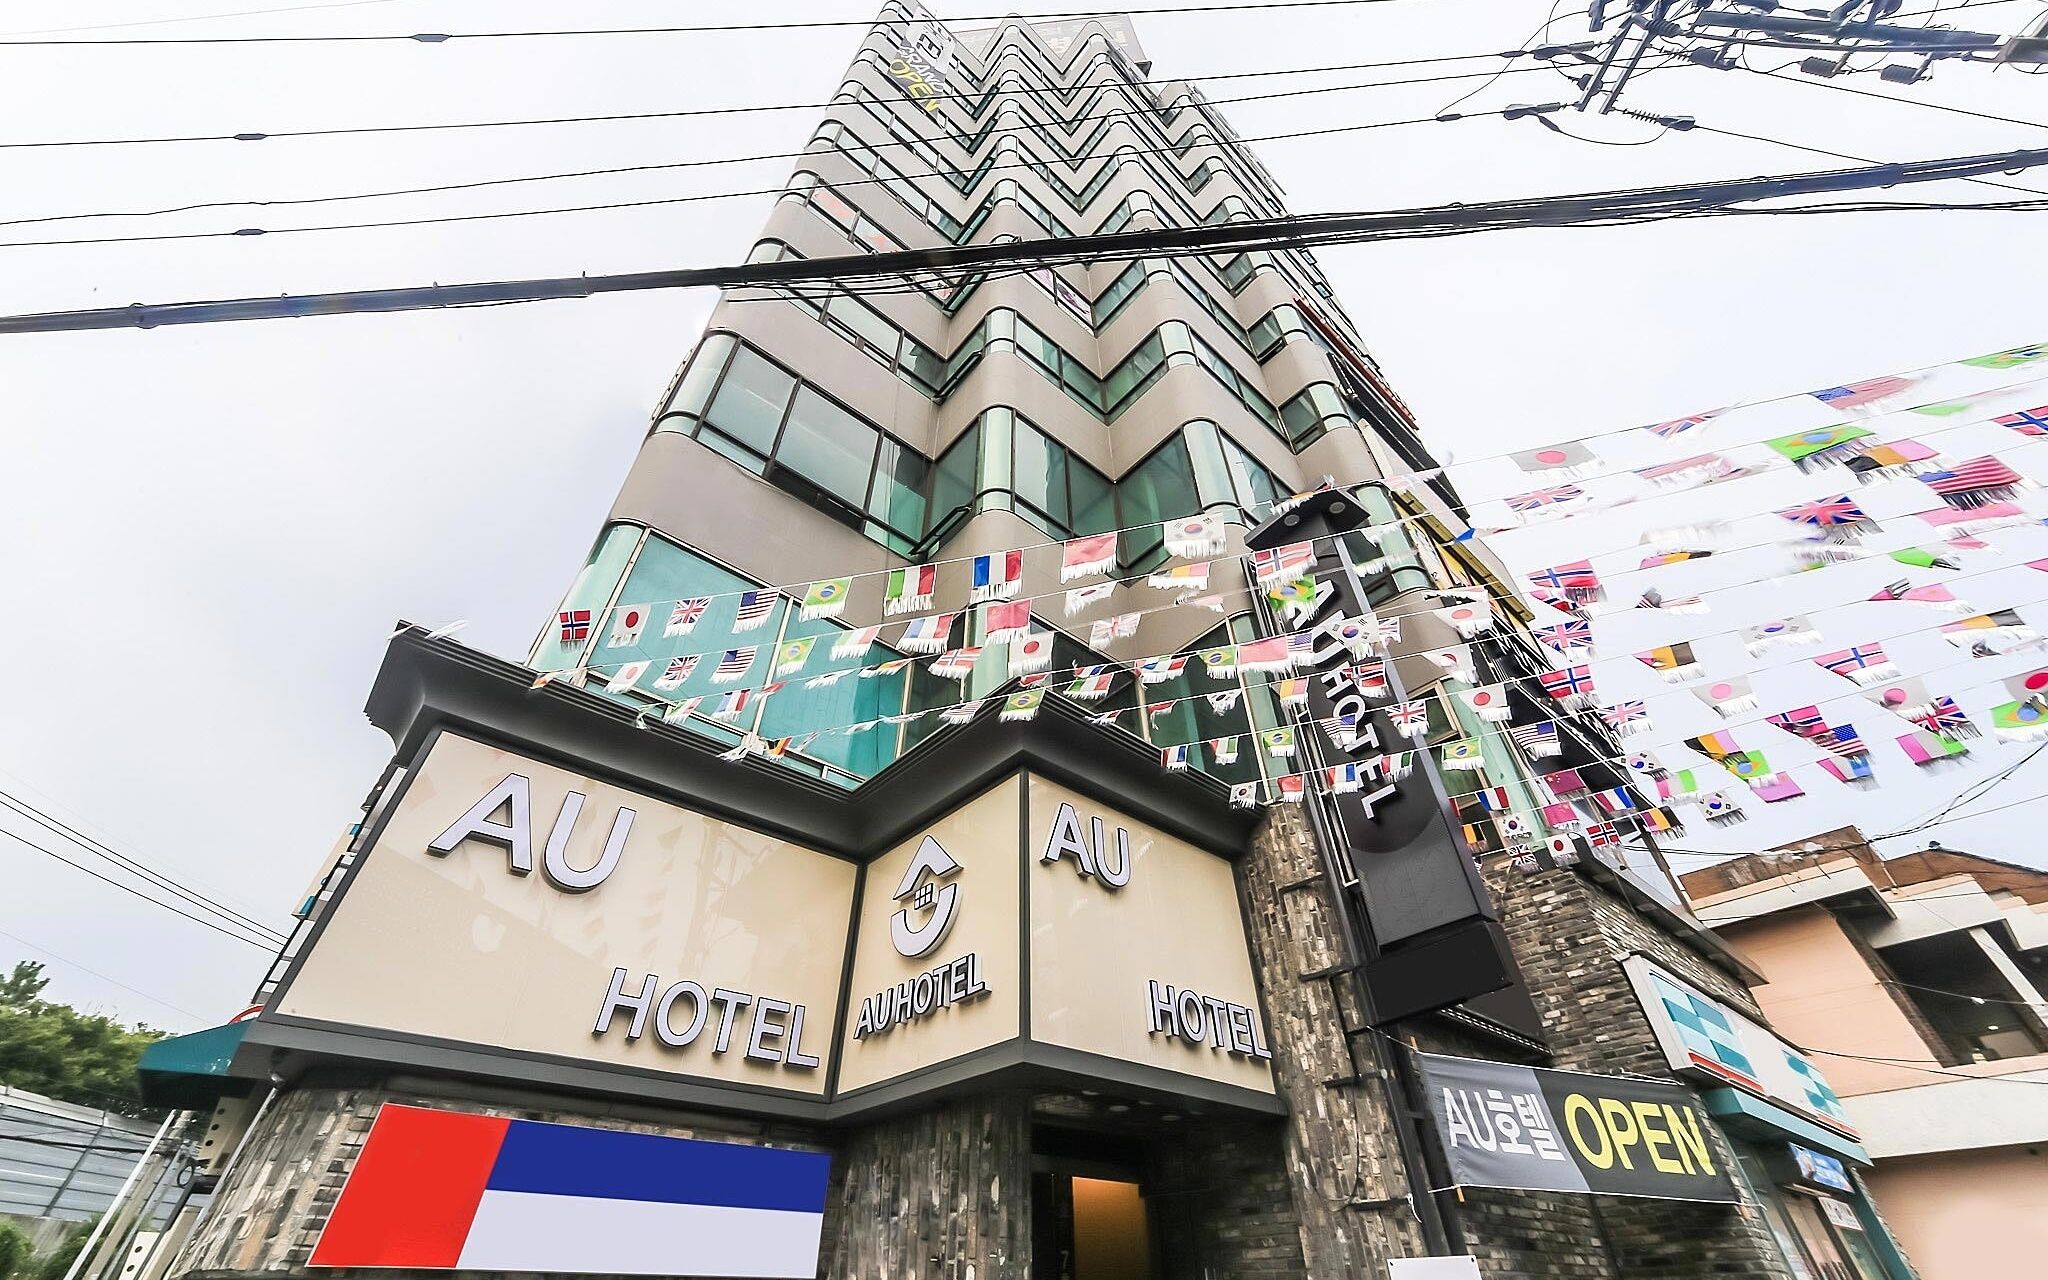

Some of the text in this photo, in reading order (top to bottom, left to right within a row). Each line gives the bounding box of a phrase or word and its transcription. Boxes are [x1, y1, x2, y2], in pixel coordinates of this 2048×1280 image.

[889, 58, 941, 113] OPEN
[426, 772, 637, 892] AU
[1040, 802, 1132, 888] AU
[592, 966, 821, 1069] HOTEL
[1144, 979, 1272, 1059] HOTEL
[1563, 1093, 1717, 1176] OPEN
